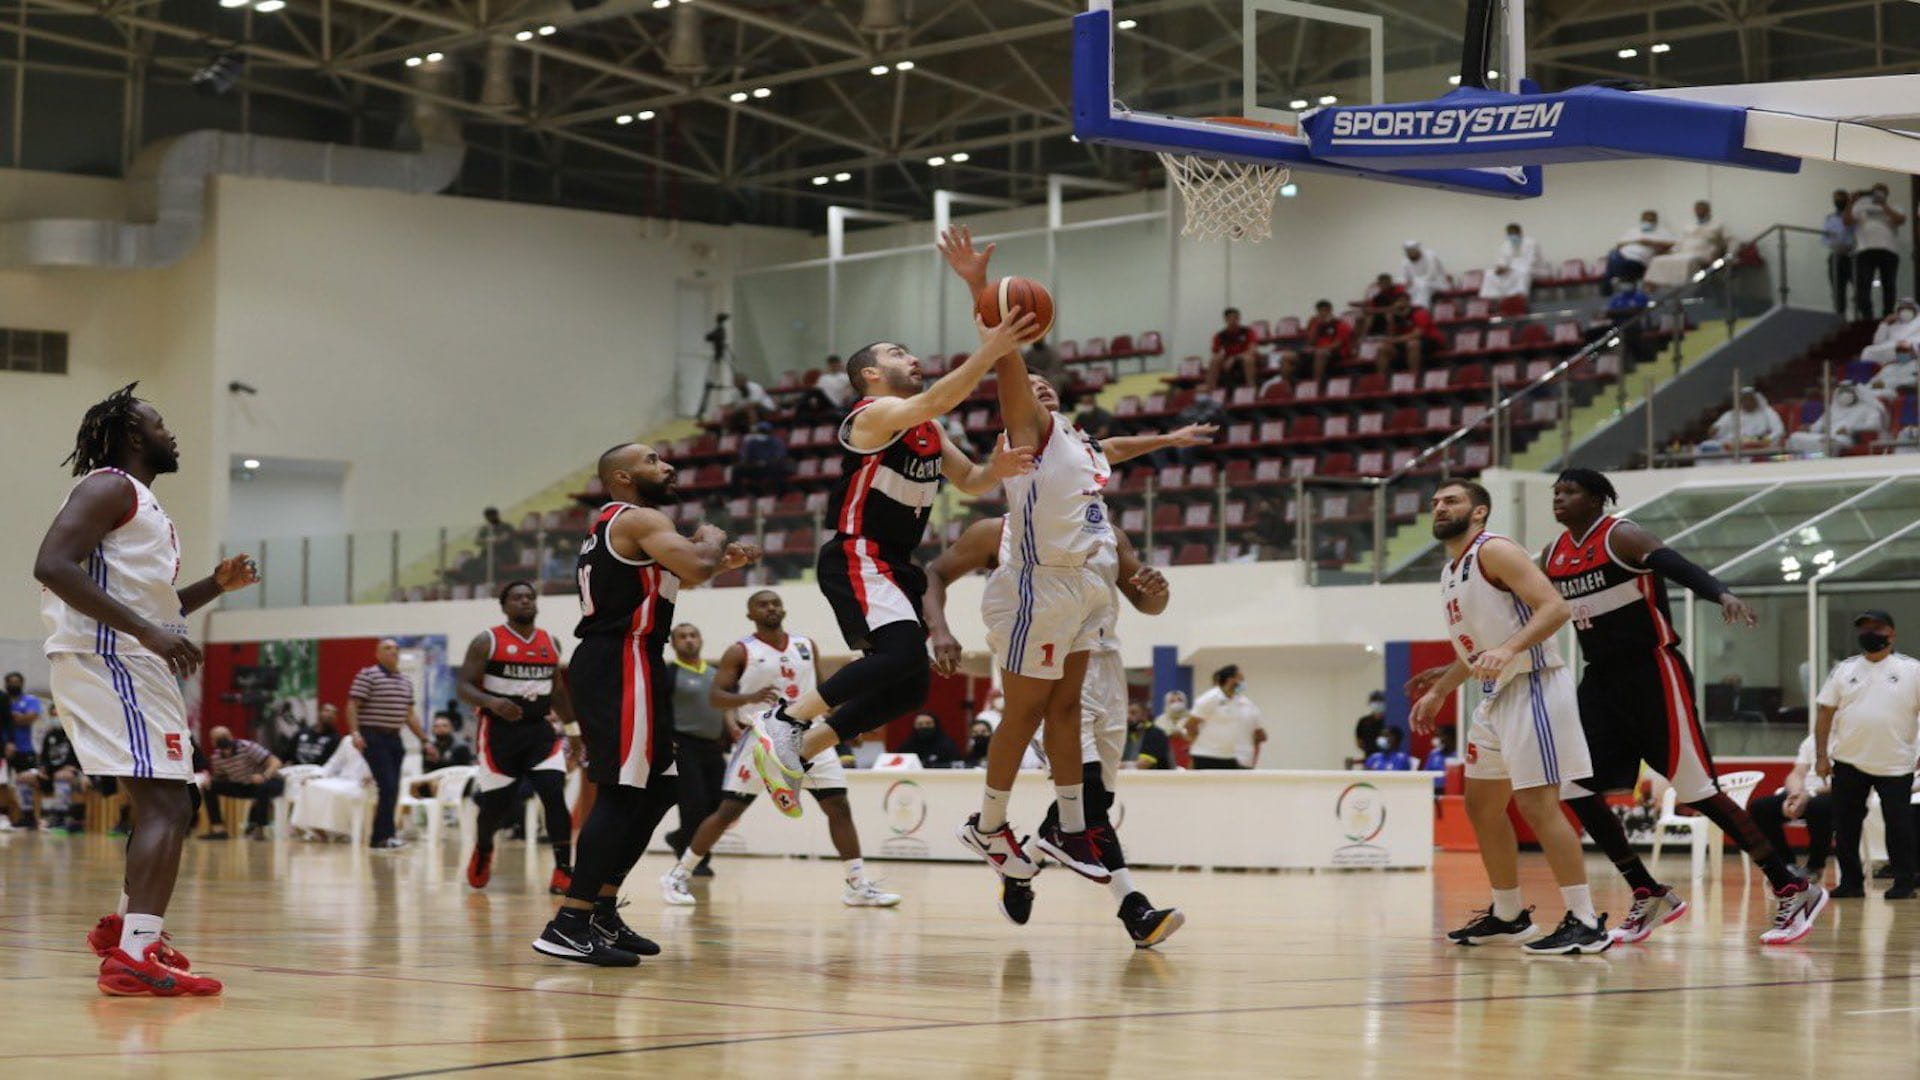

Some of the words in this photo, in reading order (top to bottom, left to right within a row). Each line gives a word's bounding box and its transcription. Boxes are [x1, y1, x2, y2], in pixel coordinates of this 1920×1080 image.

[1332, 102, 1565, 143] SPORTSYSTEM
[1041, 643, 1055, 667] 1
[164, 733, 183, 761] 5
